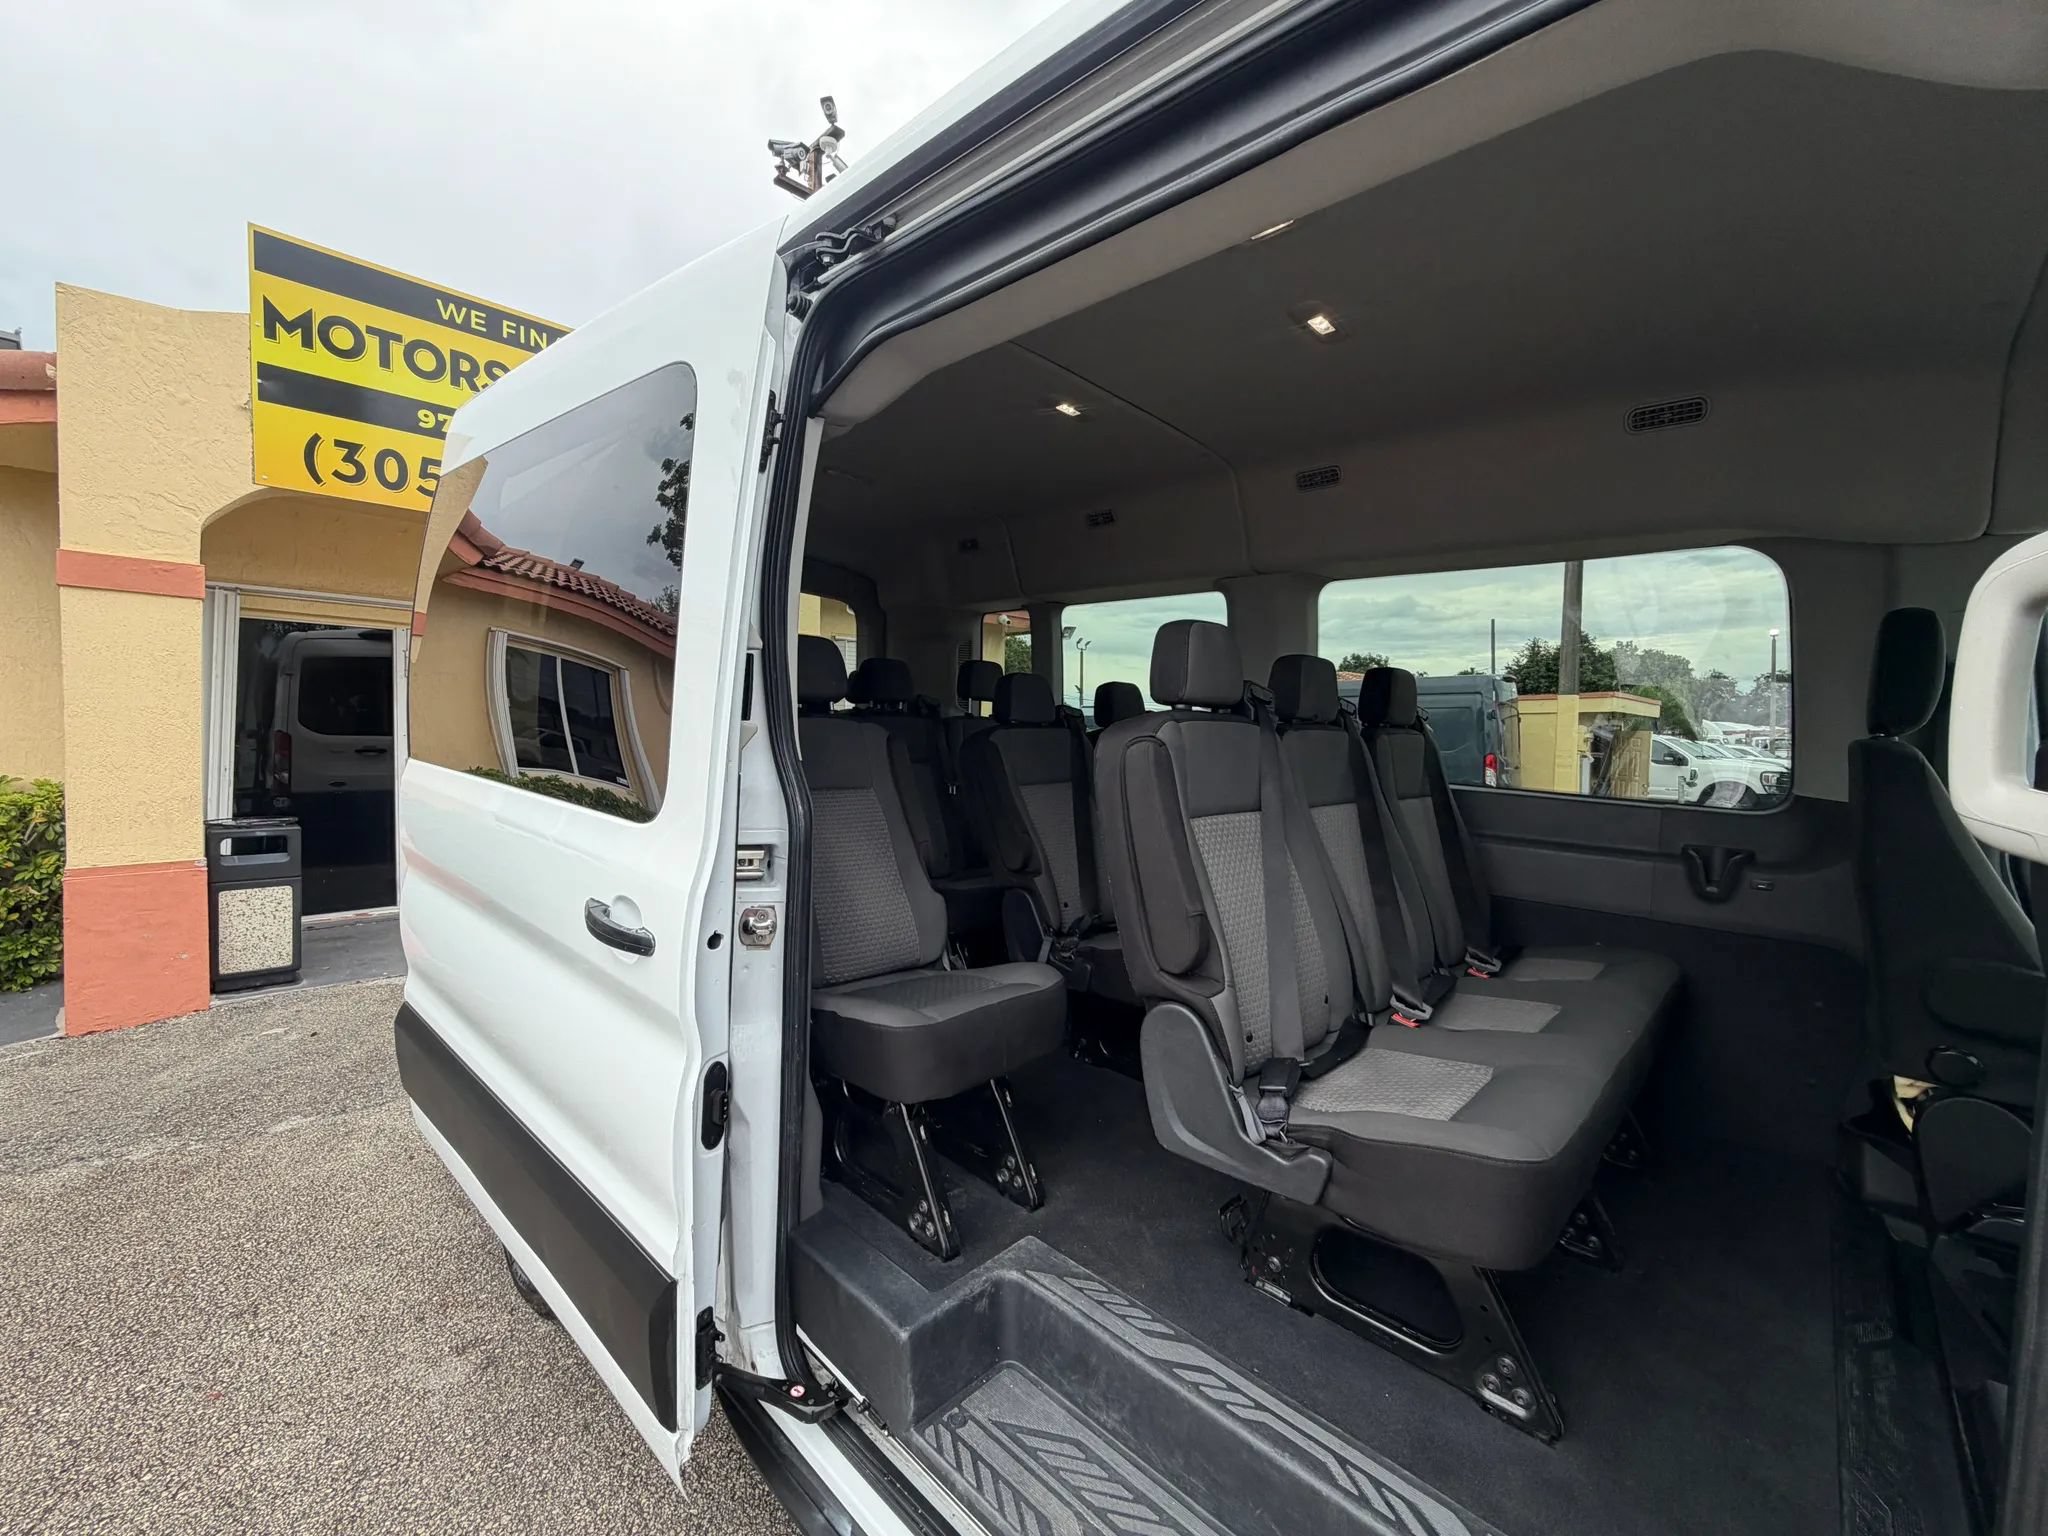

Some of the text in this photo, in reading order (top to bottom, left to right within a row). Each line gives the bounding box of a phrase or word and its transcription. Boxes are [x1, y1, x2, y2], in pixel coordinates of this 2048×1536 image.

[436, 299, 561, 350] WE FIN
[417, 409, 453, 433] 97
[304, 433, 441, 497] (305
